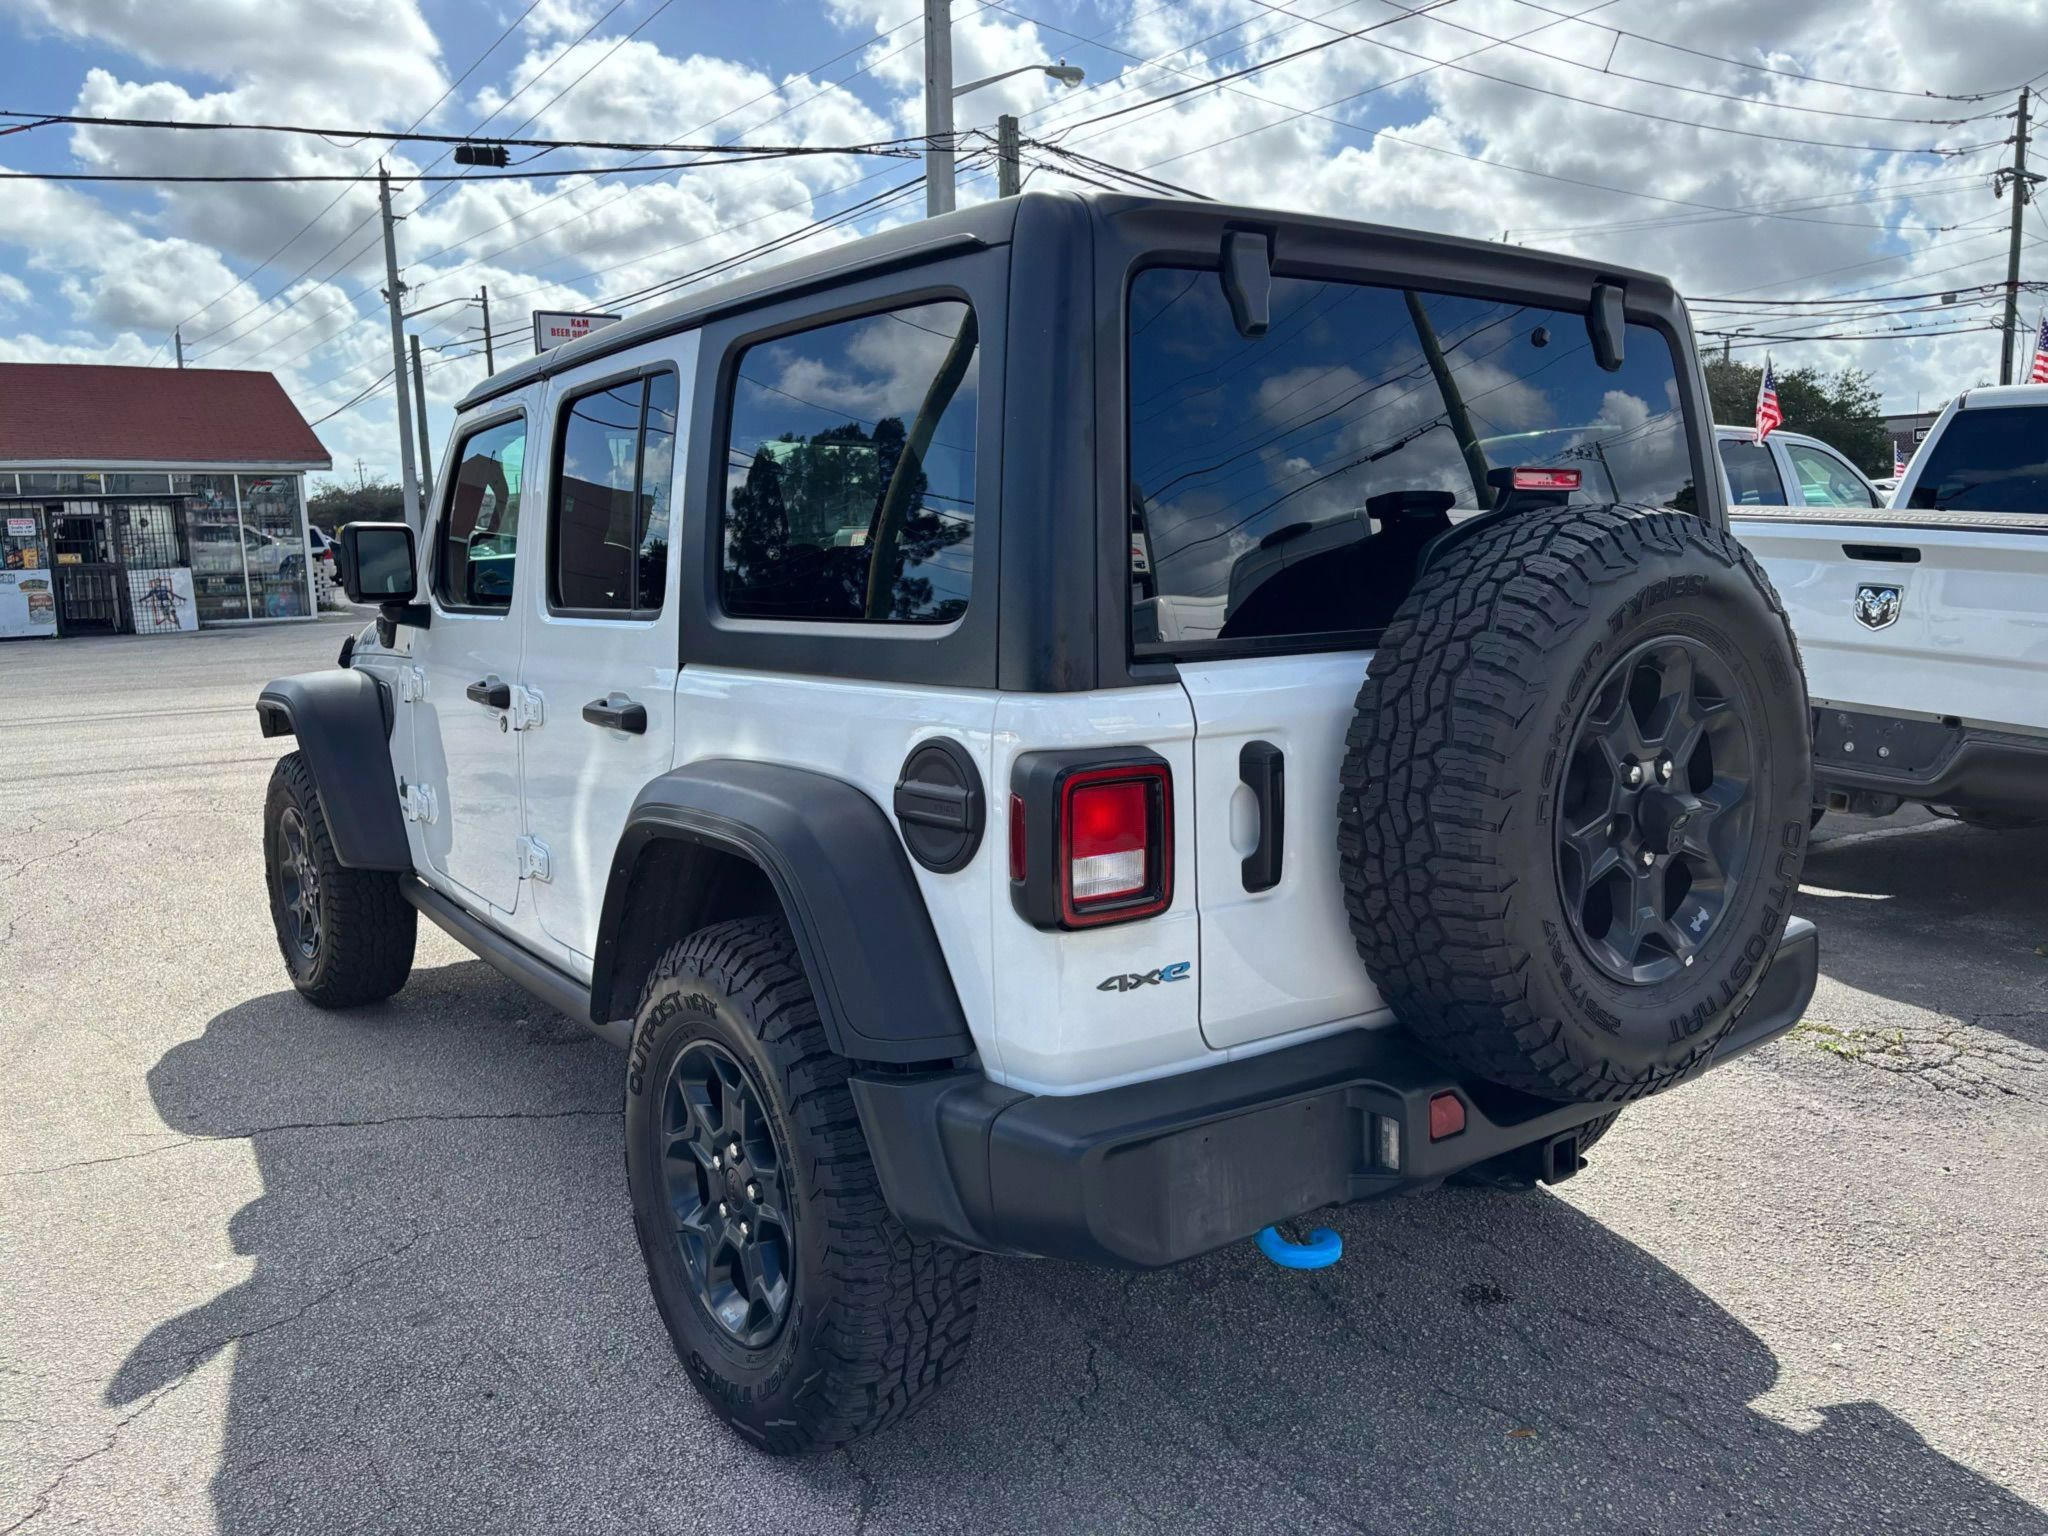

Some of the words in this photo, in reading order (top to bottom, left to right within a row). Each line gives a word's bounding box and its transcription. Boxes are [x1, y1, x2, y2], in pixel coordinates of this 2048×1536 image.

[551, 328, 570, 337] BEER
[570, 318, 589, 327] K&M
[1719, 818, 1802, 1007] OUTPOST
[629, 989, 684, 1097] OUTPOST
